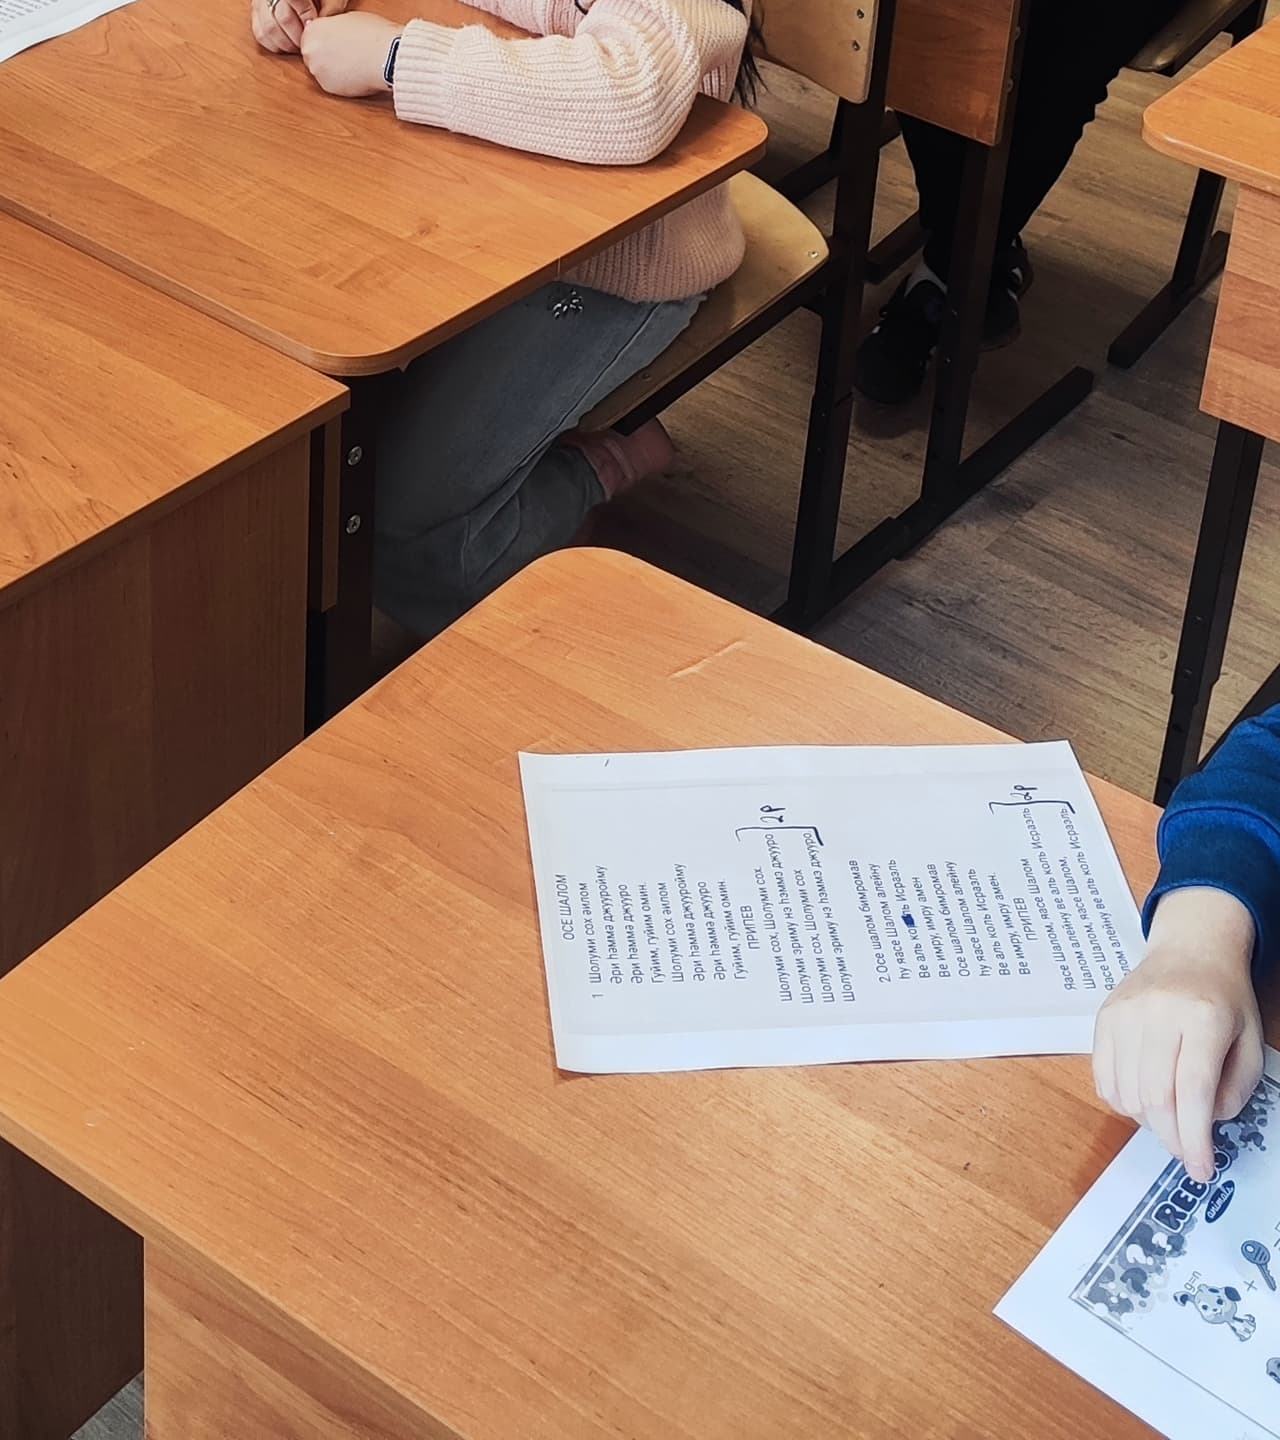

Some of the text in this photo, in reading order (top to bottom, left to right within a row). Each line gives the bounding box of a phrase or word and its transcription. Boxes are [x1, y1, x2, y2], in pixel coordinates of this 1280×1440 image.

[765, 834, 784, 869] джууро
[596, 865, 614, 922] джууройму
[1021, 859, 1040, 894] Шалом
[555, 874, 575, 940] ОСЕ ШАЛОМ
[618, 885, 633, 922] джууро
[759, 888, 776, 930] Шолуми
[783, 906, 794, 919] нэ
[1023, 808, 1096, 989] Шалом алейну ве аль коль Исраэль
[1034, 897, 1051, 920] яасе
[584, 919, 595, 935] сох
[644, 914, 658, 945] гуйим
[665, 918, 676, 935] сох
[740, 906, 760, 949] ПРИПЕВ
[785, 921, 804, 954] эриму
[587, 939, 602, 983] Шолуми
[668, 938, 684, 982] Шолуми
[1059, 965, 1077, 990] Яасе
[774, 957, 792, 1001] Шолуми
[795, 958, 814, 1003] Шолуми
